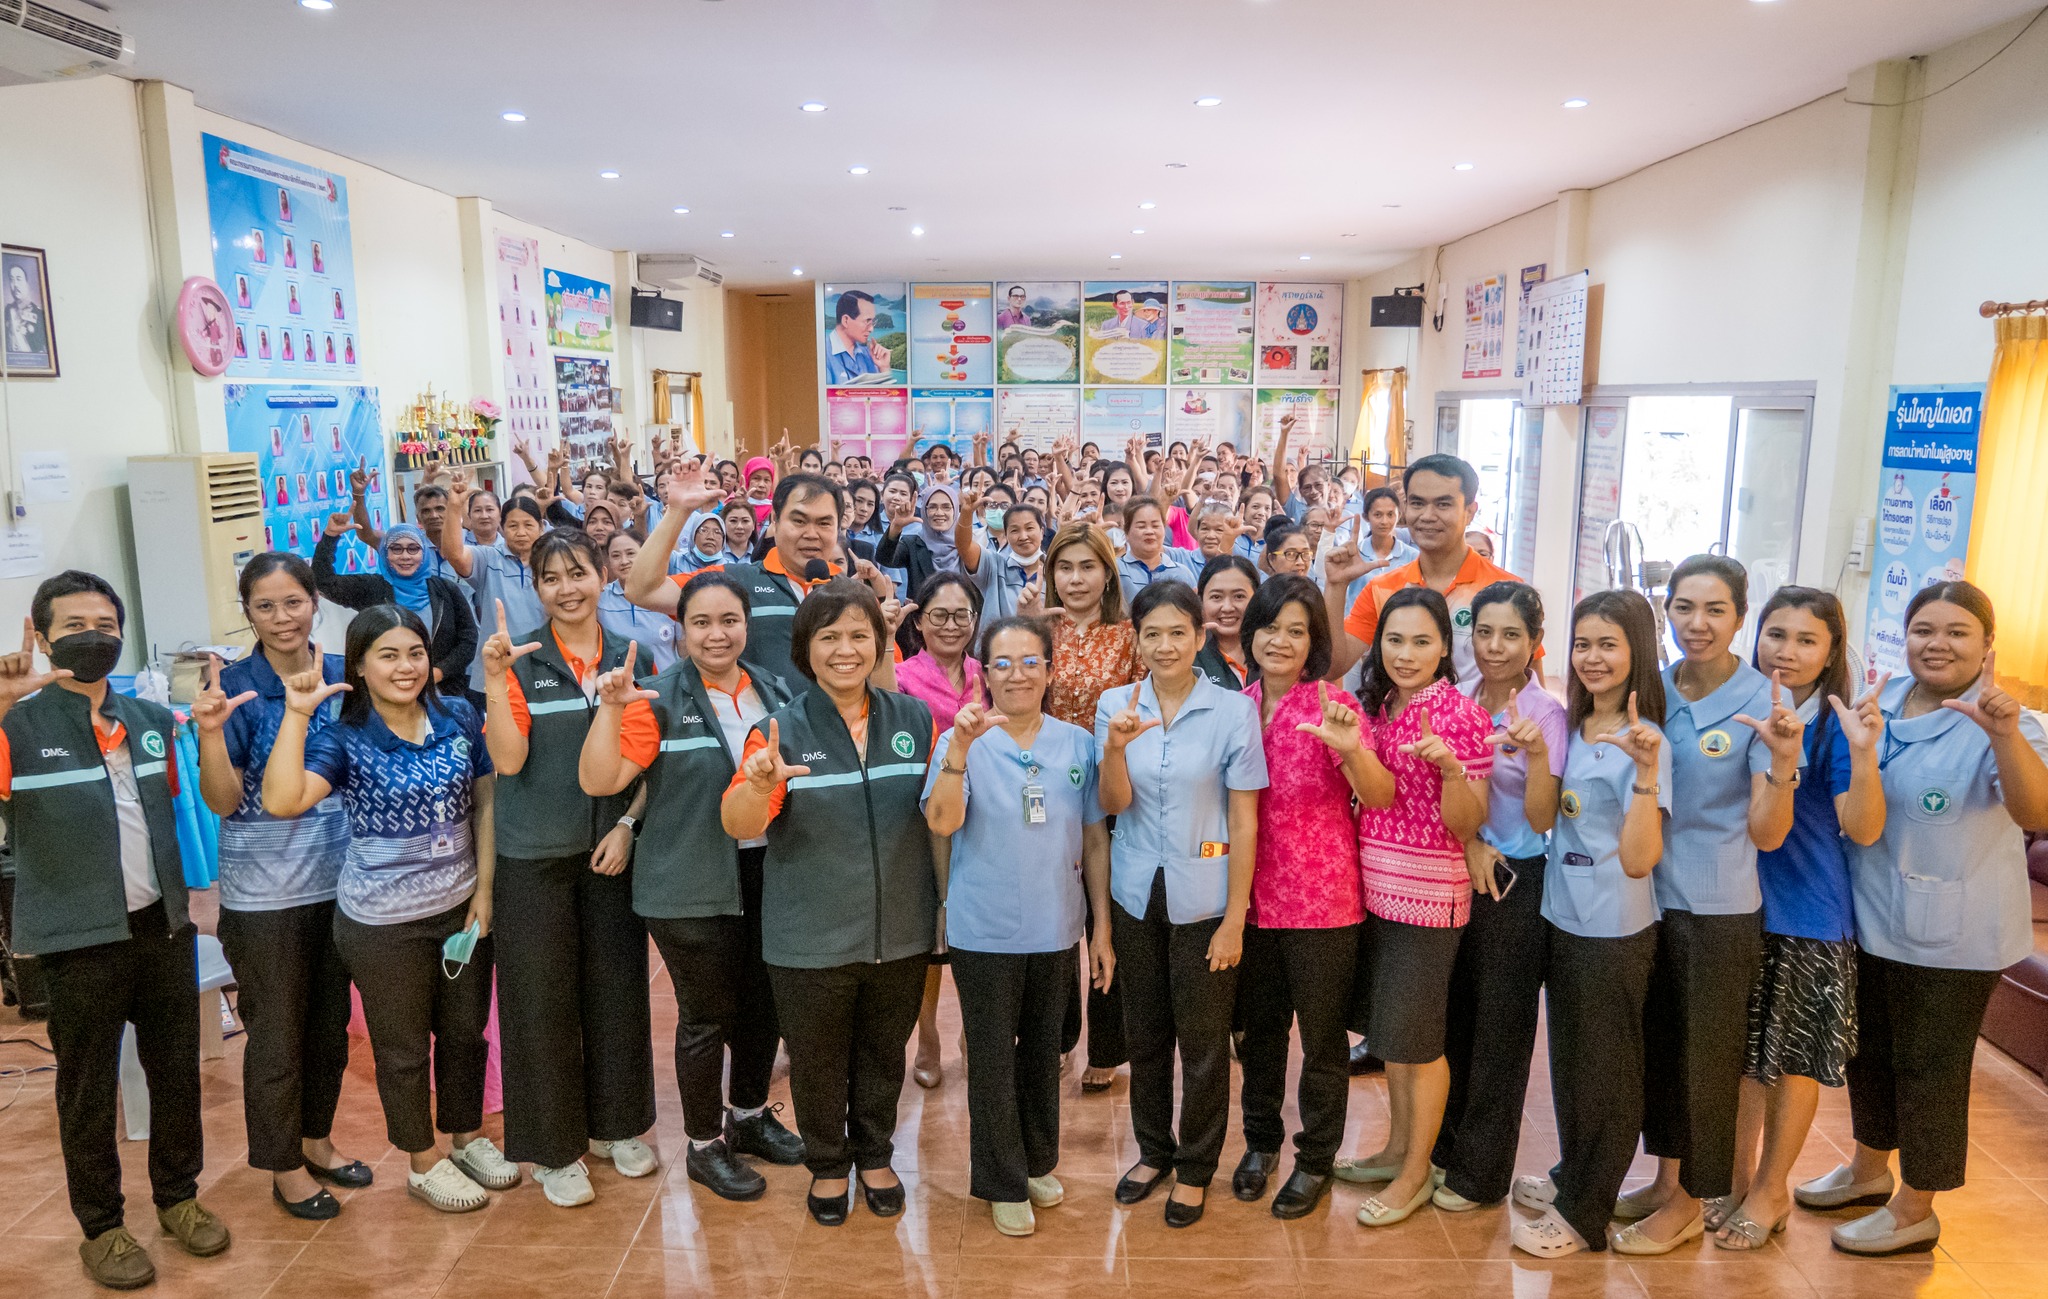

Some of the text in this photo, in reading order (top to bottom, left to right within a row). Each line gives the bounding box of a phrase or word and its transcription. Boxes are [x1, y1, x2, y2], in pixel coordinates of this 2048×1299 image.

[1888, 439, 1973, 465] การลดน้ำหนักในผู้สูงอายุ
[1929, 494, 1952, 512] เลือก
[1887, 566, 1907, 586] ดื่มน้ำ
[534, 679, 559, 689] DMSc
[682, 715, 704, 724] DMSc
[41, 747, 70, 758] DMSc
[802, 751, 827, 762] DMSc
